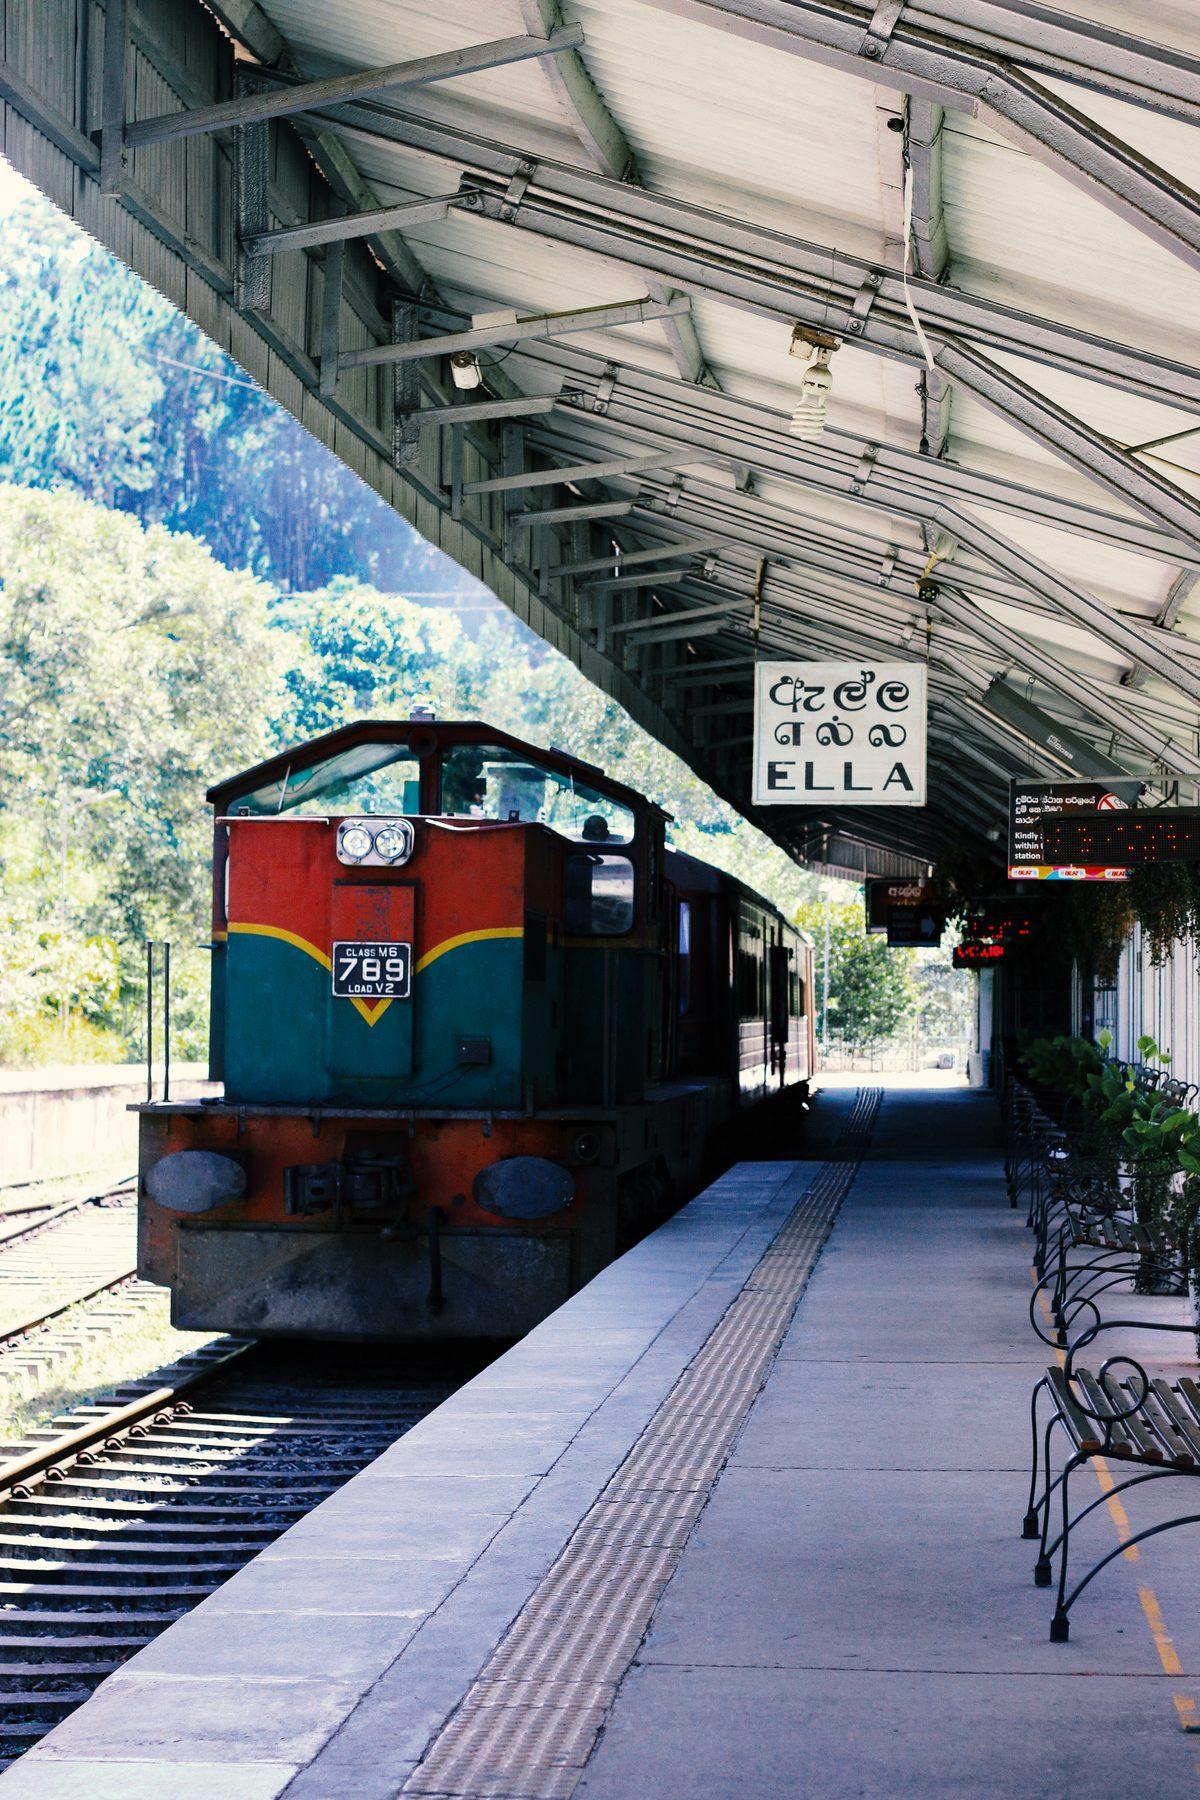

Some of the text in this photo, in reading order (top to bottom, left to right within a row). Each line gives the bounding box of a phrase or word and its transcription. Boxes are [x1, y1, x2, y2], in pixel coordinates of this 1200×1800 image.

[769, 670, 910, 713] ඇල්ල
[774, 715, 907, 748] எல்ல
[767, 761, 914, 791] ELLA
[1014, 832, 1039, 841] Kindly
[1014, 852, 1041, 860] station
[346, 947, 398, 957] CLASS M6
[339, 958, 404, 981] 789
[348, 983, 394, 993] LOAD V2
